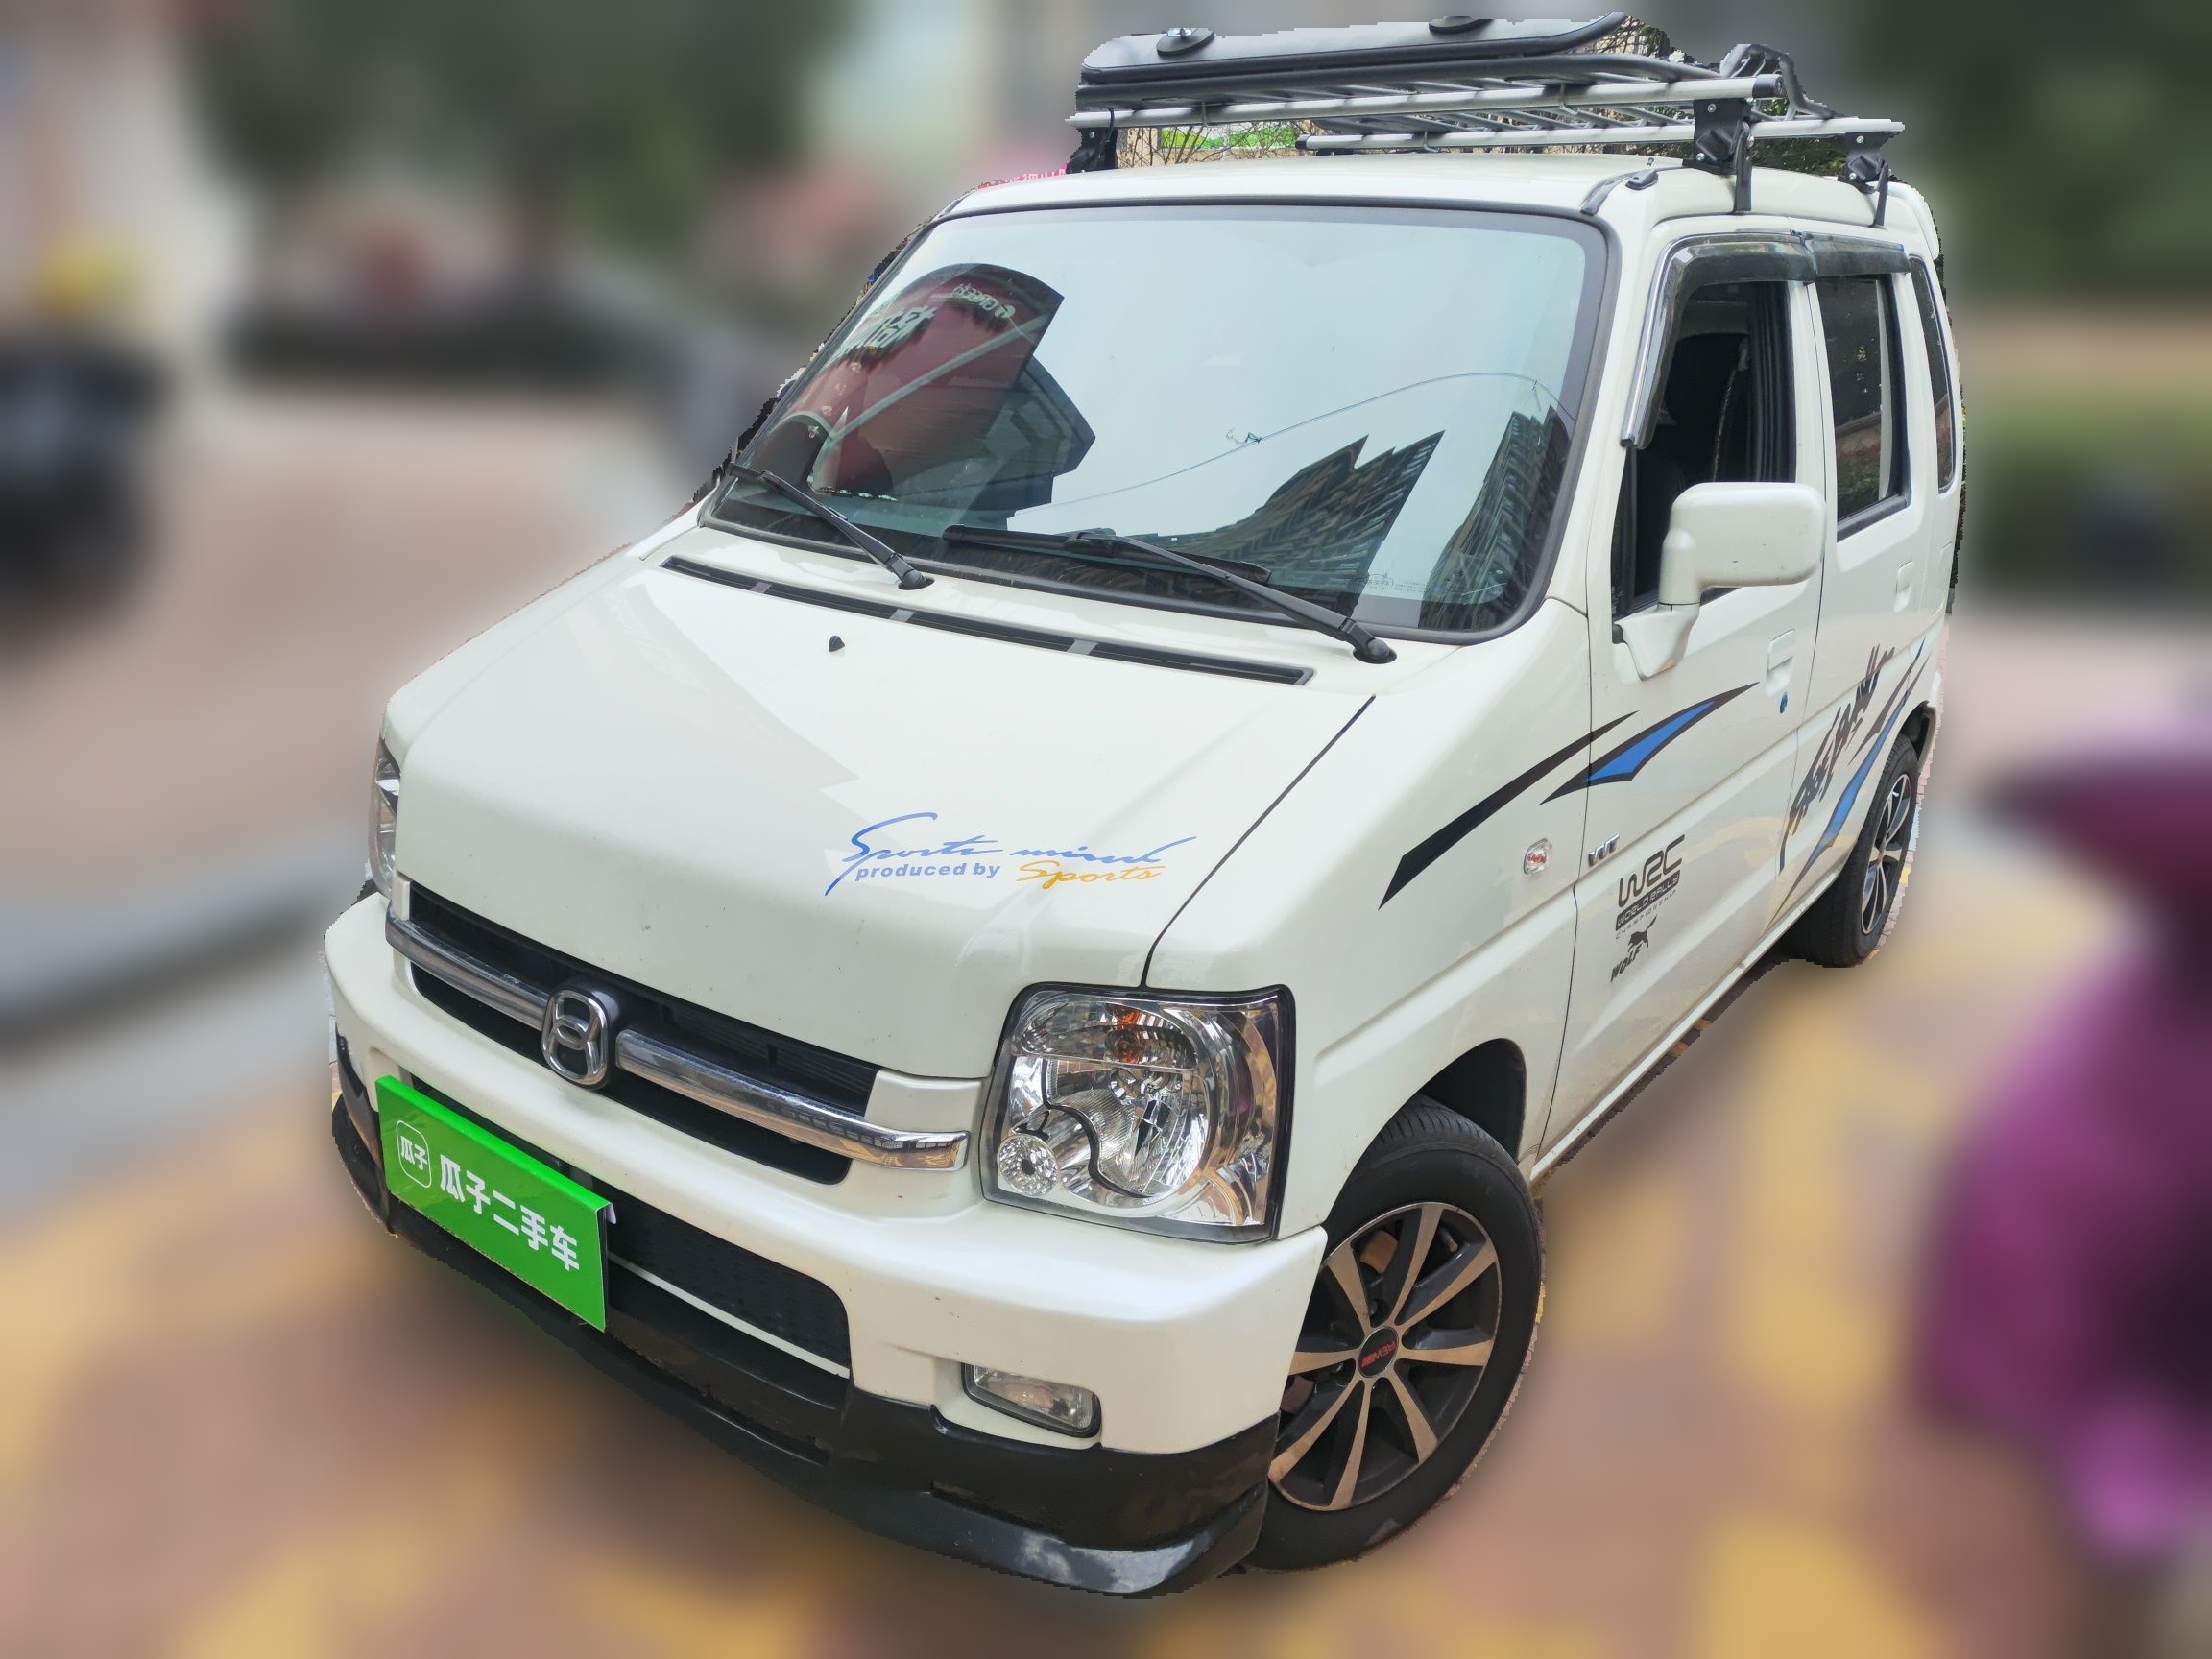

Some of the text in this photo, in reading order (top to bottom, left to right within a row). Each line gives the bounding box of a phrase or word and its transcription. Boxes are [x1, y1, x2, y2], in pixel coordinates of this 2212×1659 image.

[825, 811, 1004, 897] Sports
[855, 860, 1166, 891] produced by Sports
[1618, 834, 1686, 907] WRC
[1610, 943, 1643, 983] WOLF
[400, 1135, 428, 1171] 瓜子
[439, 1154, 580, 1272] 瓜子二手车
